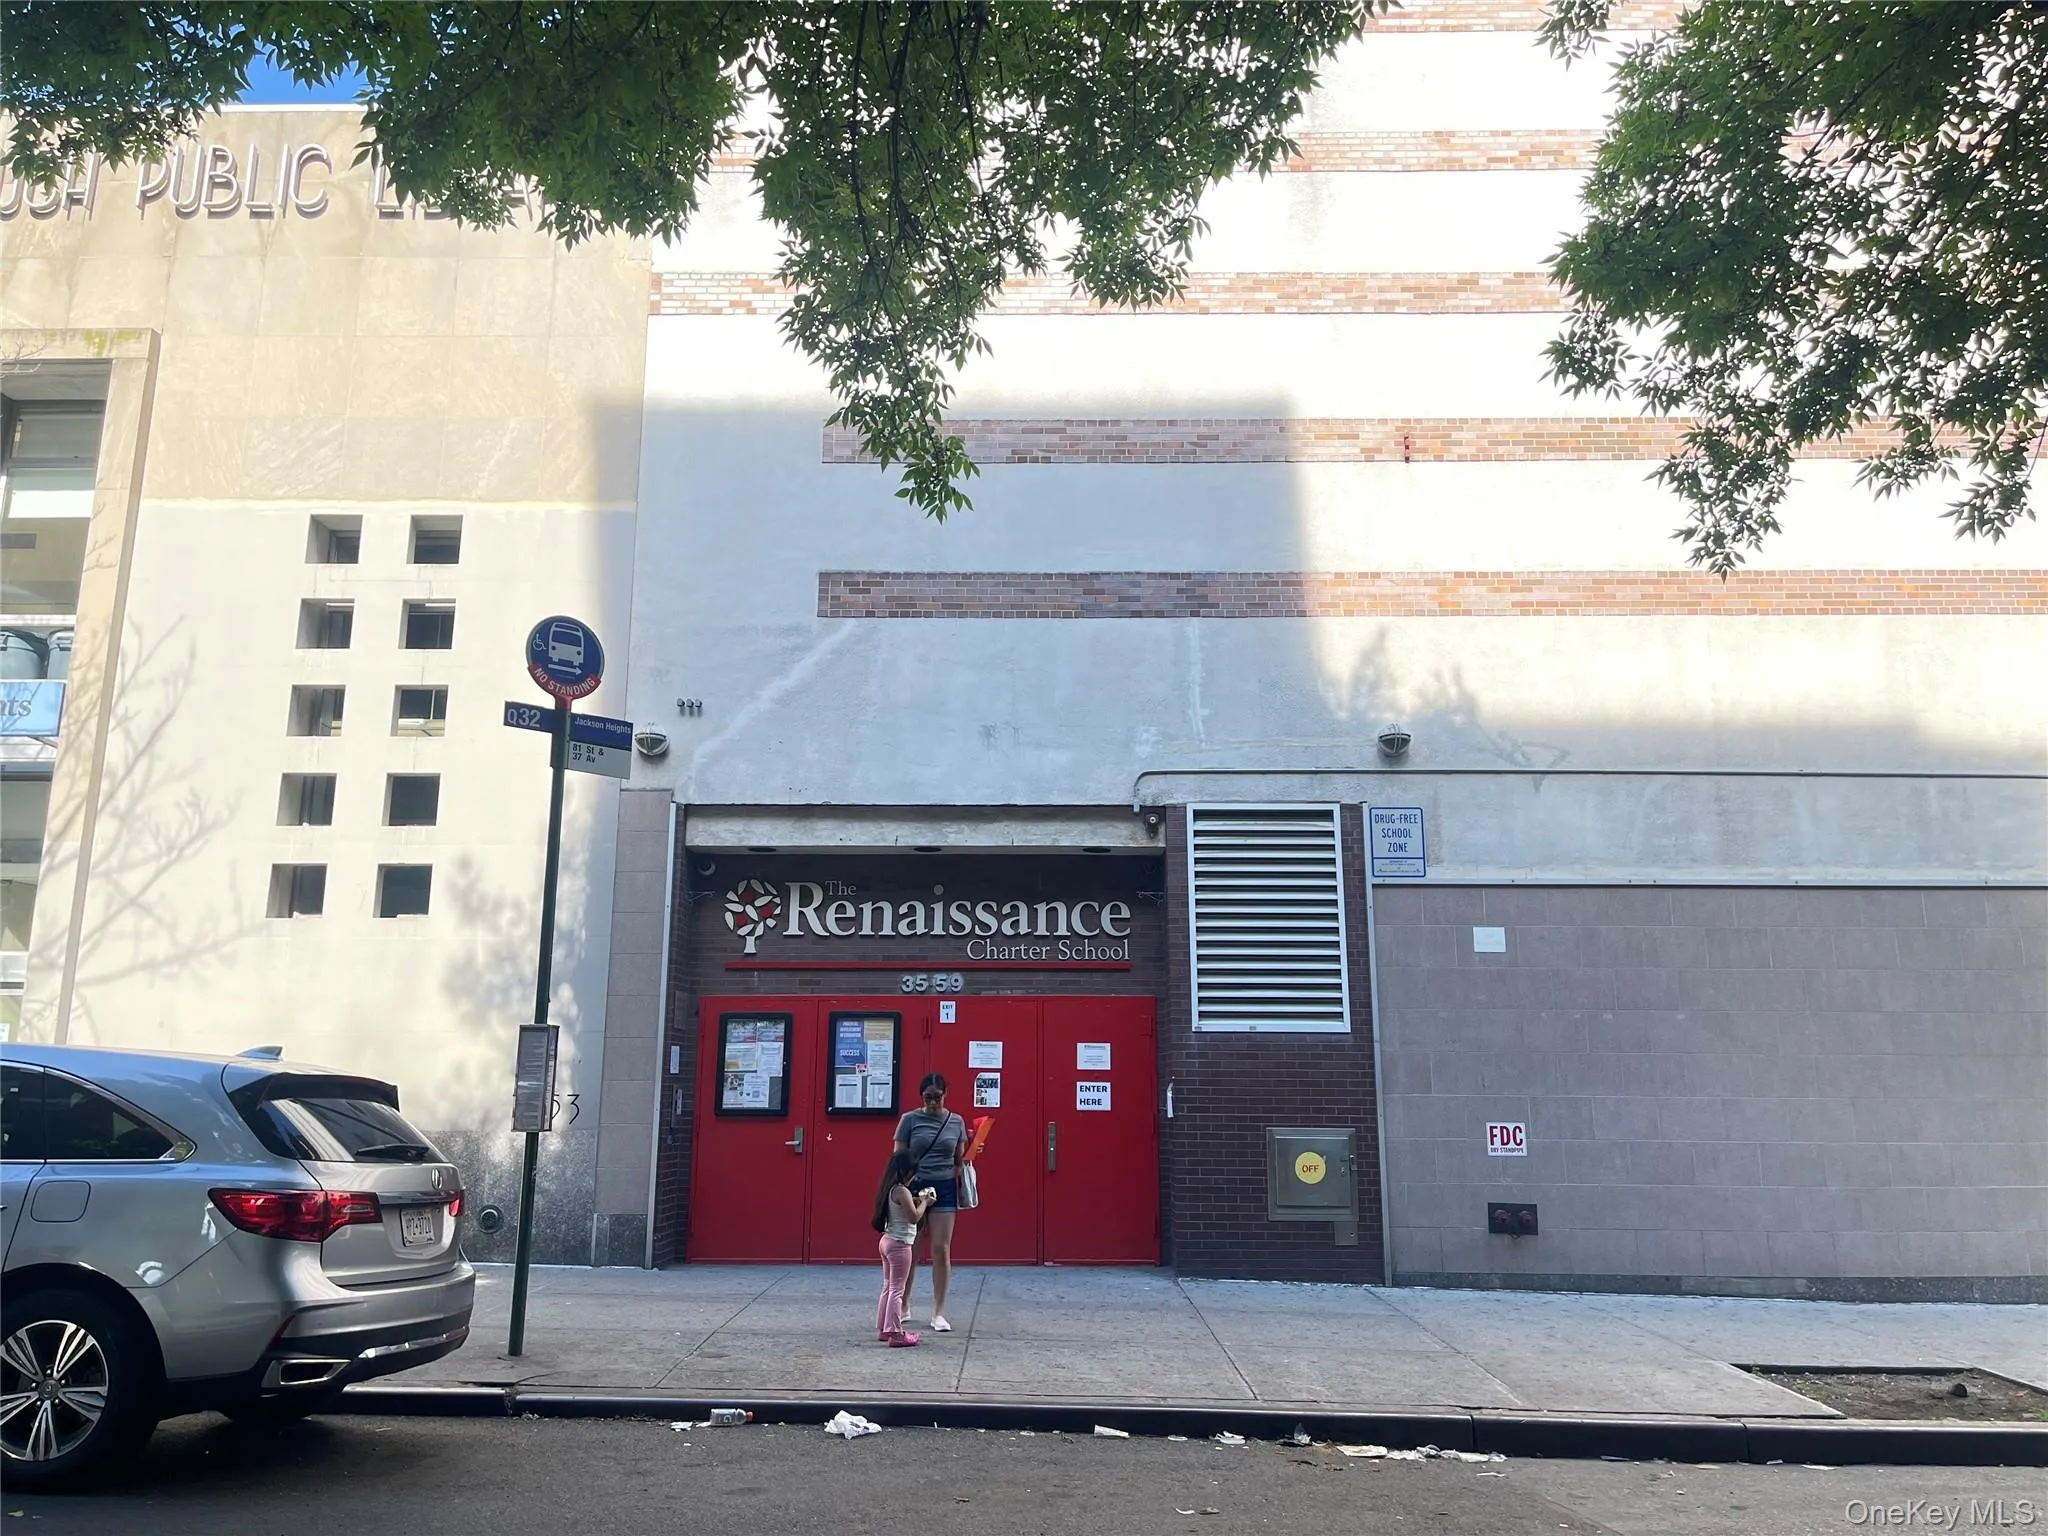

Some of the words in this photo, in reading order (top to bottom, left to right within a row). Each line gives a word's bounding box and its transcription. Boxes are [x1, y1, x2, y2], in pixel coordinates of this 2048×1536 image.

[136, 144, 331, 217] PUBLIC
[534, 667, 547, 684] NO
[548, 677, 596, 695] STANDING
[507, 708, 541, 728] Q32
[574, 717, 604, 729] Jackson
[605, 720, 632, 735] Heights
[572, 743, 582, 752] 81
[572, 752, 582, 761] 37
[586, 754, 596, 763] Av
[1374, 813, 1419, 824] DRUG-FREE
[1381, 828, 1413, 838] SCHOOL
[1387, 842, 1409, 853] ZONE
[825, 881, 857, 896] The
[783, 881, 1132, 937] Renaissance
[966, 940, 1050, 961] Charter
[1057, 939, 1130, 961] School
[1079, 1085, 1108, 1093] ENTER
[1079, 1098, 1102, 1106] HERE
[1489, 1125, 1523, 1146] FDC
[1302, 1164, 1320, 1173] OFF
